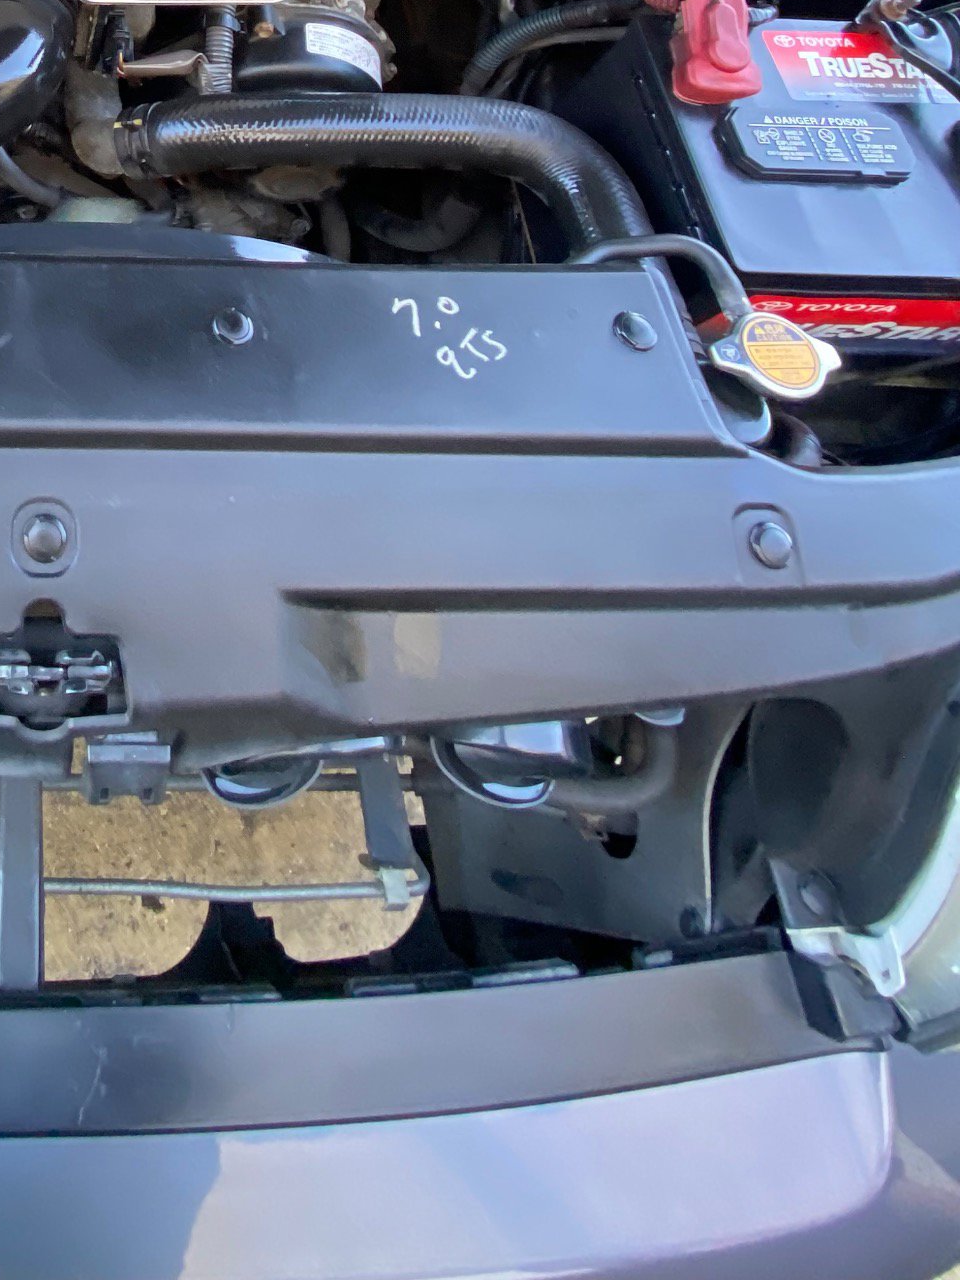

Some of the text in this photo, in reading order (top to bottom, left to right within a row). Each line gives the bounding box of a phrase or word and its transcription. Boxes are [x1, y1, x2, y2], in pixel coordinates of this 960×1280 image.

[796, 36, 855, 48] TOYOTA
[798, 52, 929, 79] TRUESTA
[773, 116, 819, 126] DANGER
[828, 117, 869, 127] POISON
[795, 303, 897, 313] TOYOTA
